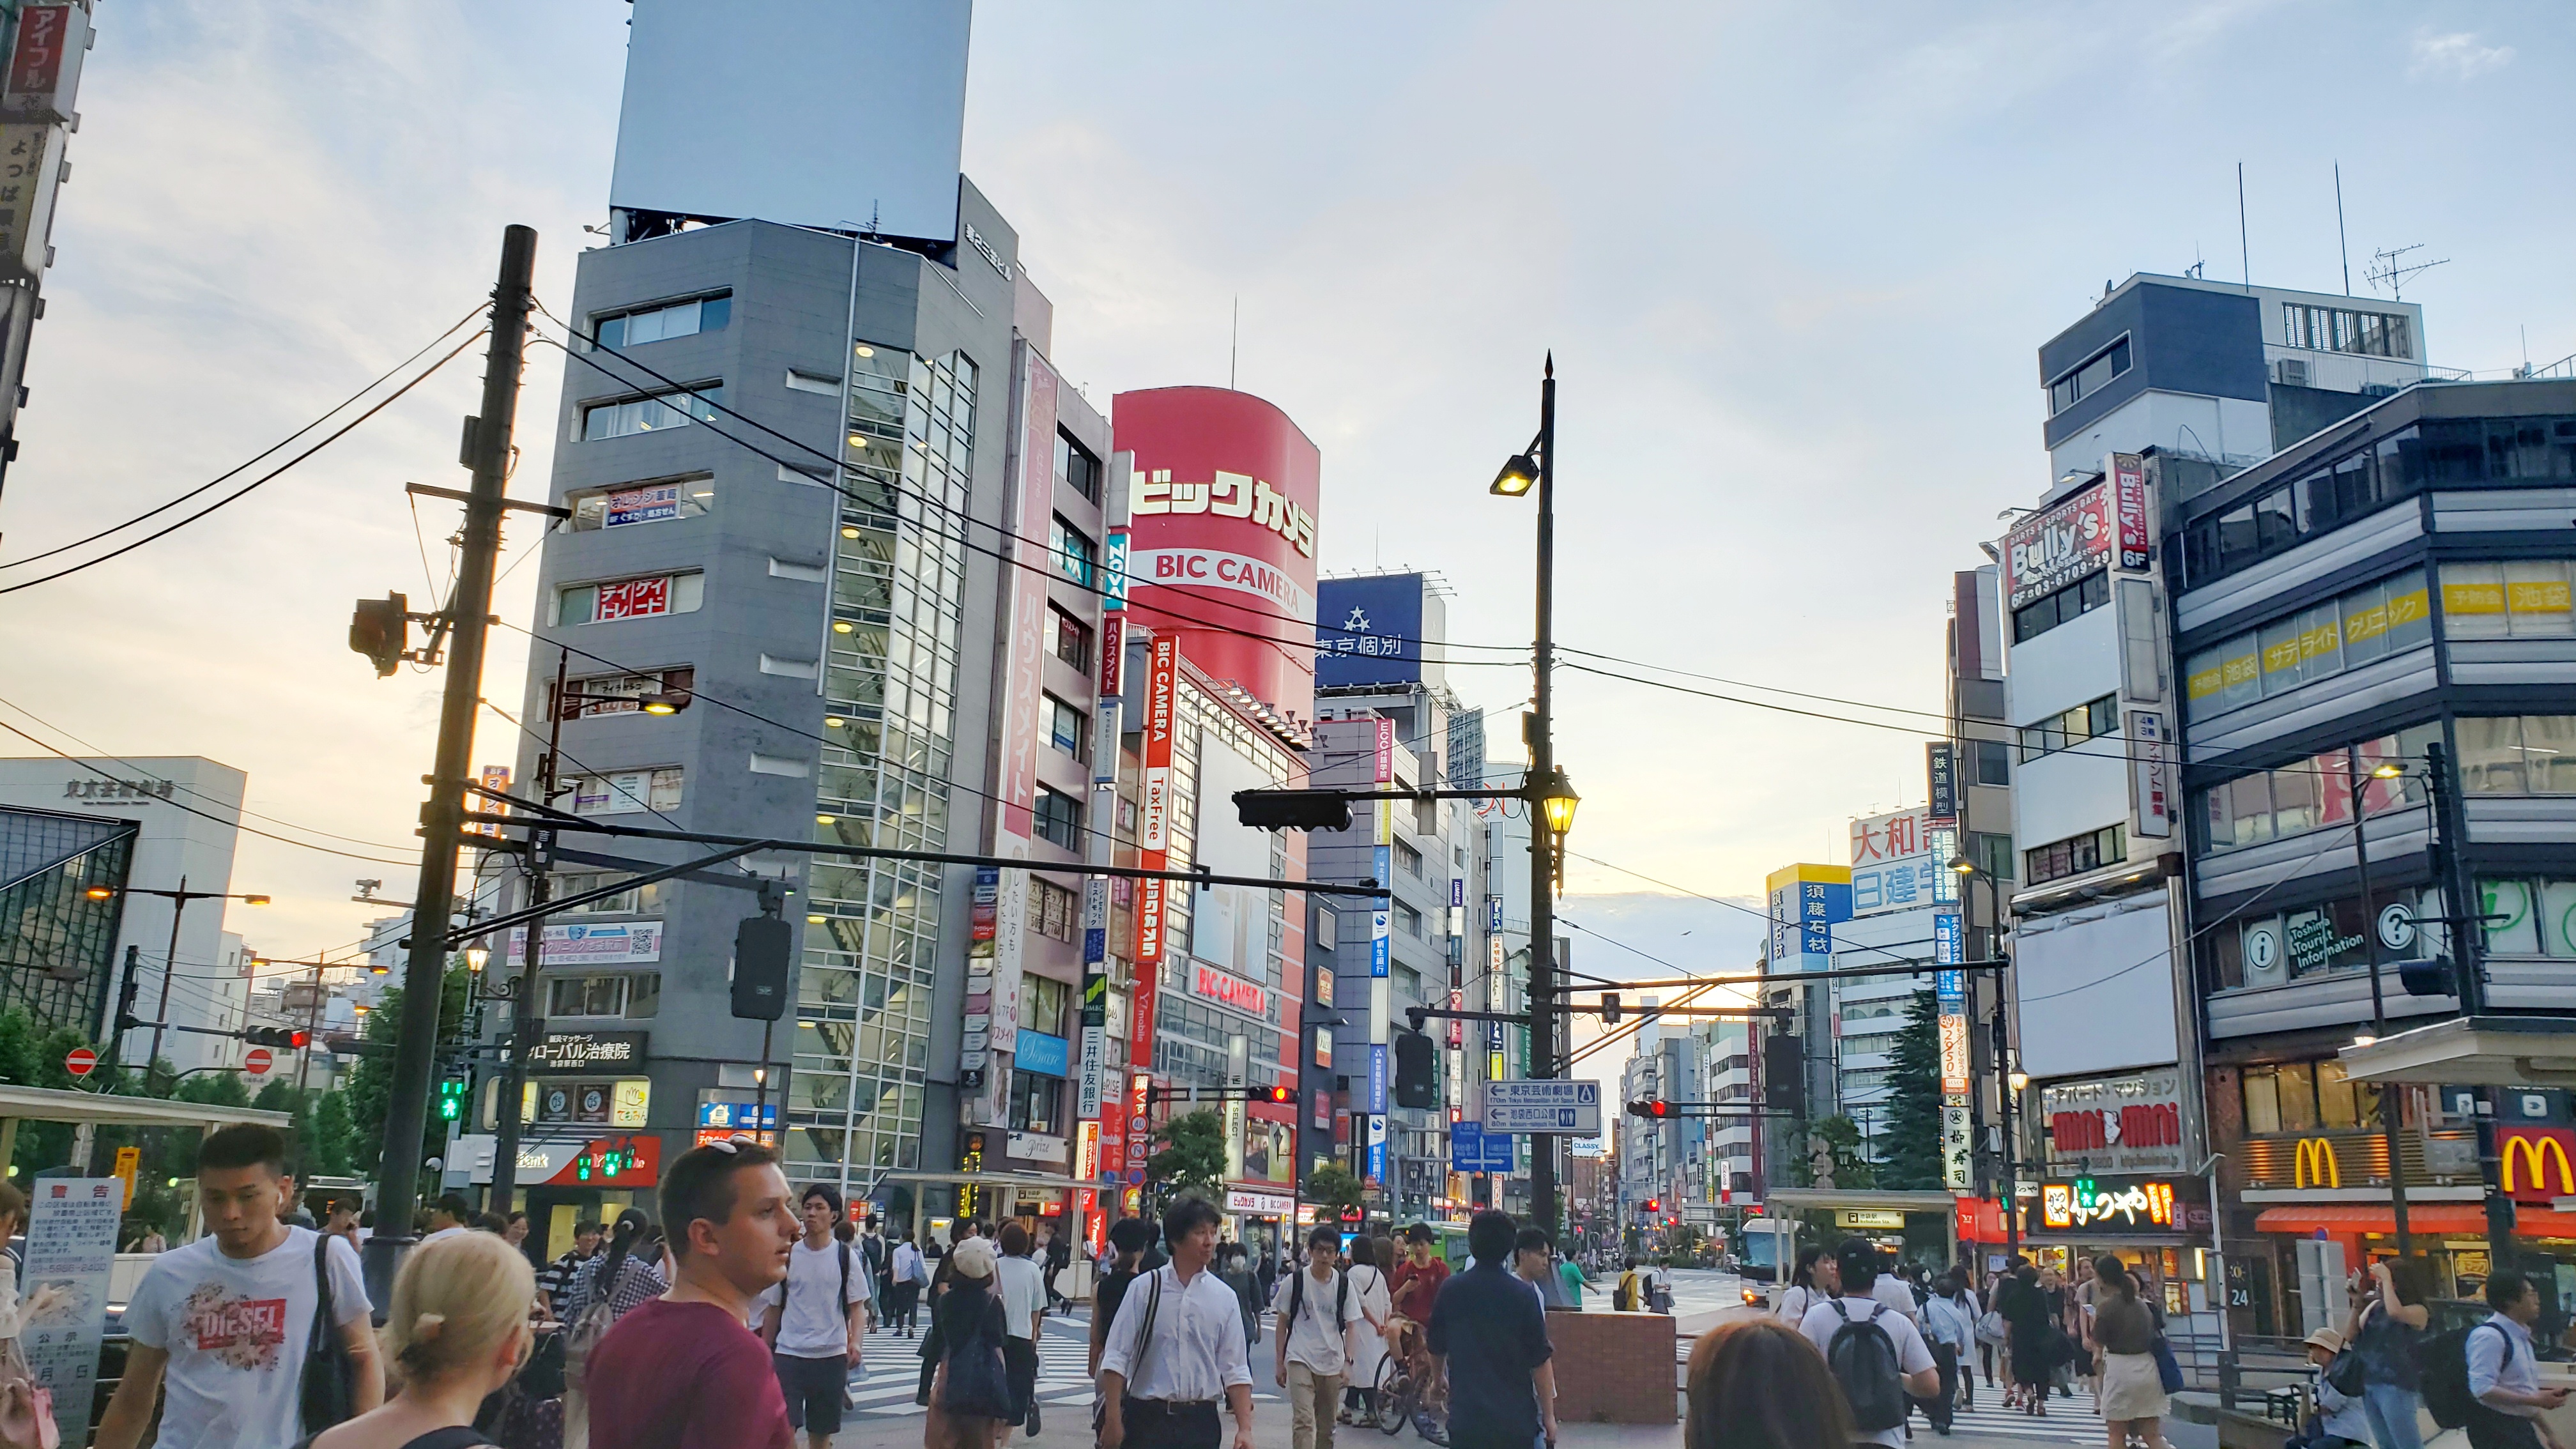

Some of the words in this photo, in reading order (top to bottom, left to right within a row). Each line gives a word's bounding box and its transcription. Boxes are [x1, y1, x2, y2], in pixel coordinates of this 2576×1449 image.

[24, 9, 56, 89] アイフル
[1131, 470, 1314, 559] ビックカメラ
[2011, 526, 2034, 546] DARTS
[2046, 503, 2077, 526] SPORTS
[2080, 493, 2097, 508] BAR
[2119, 473, 2138, 546] Bully's
[2011, 510, 2099, 578] Bully's
[2123, 550, 2146, 567] 6F
[1105, 544, 1124, 599] NOVA
[1156, 555, 1208, 578] BIC
[1216, 559, 1299, 614] CAMERA
[2012, 590, 2025, 608] 6F
[2035, 550, 2109, 596] 03-6709-29
[601, 597, 663, 620] トレード
[2517, 585, 2570, 608] 池袋
[1105, 622, 1118, 690] ハウスメイト
[1157, 641, 1170, 668] BIC
[1315, 634, 1401, 659] 東京個別
[2226, 656, 2257, 682] 池袋
[2270, 632, 2338, 666] サテライト
[2347, 599, 2416, 640] クリニック
[1014, 593, 1038, 804] ハウスメイト
[1153, 672, 1170, 742] CAMERA
[1933, 756, 1949, 814] 鉄道模型
[2148, 741, 2165, 816] テナント募集
[1142, 877, 1159, 956] ビックカメラ
[1773, 890, 1784, 959] 須藤石材
[1806, 884, 1828, 953] 須藤石材
[2291, 917, 2331, 940] Toshima
[1376, 940, 1385, 974] 新生銀行
[2294, 930, 2333, 954] Tourist
[2297, 933, 2364, 968] Information
[1199, 967, 1218, 998] BIC
[1220, 976, 1266, 1015] CAMERA
[549, 1034, 594, 1043] 鍼灸マッサージ
[1082, 1032, 1099, 1113] 三井住友銀行
[1510, 1085, 1574, 1096] 東京芸術劇場
[2055, 1079, 2176, 1105] アパート・マンション
[617, 1110, 647, 1121] てもみん
[1134, 1076, 1149, 1114] 薬くす
[1510, 1108, 1556, 1119] 池袋西口公園
[1134, 1119, 1144, 1128] 40
[2053, 1108, 2106, 1153] mini
[2122, 1101, 2179, 1148] mini
[1950, 1130, 1966, 1184] 柳寿司
[1234, 1196, 1255, 1208] ビックカメラ
[1277, 1199, 1291, 1210] CAMERA
[2232, 1290, 2249, 1306] 24
[38, 1331, 78, 1343] 公示
[203, 1306, 279, 1339] DIESEL
[40, 1367, 53, 1381] 月
[77, 1365, 88, 1379] 日
